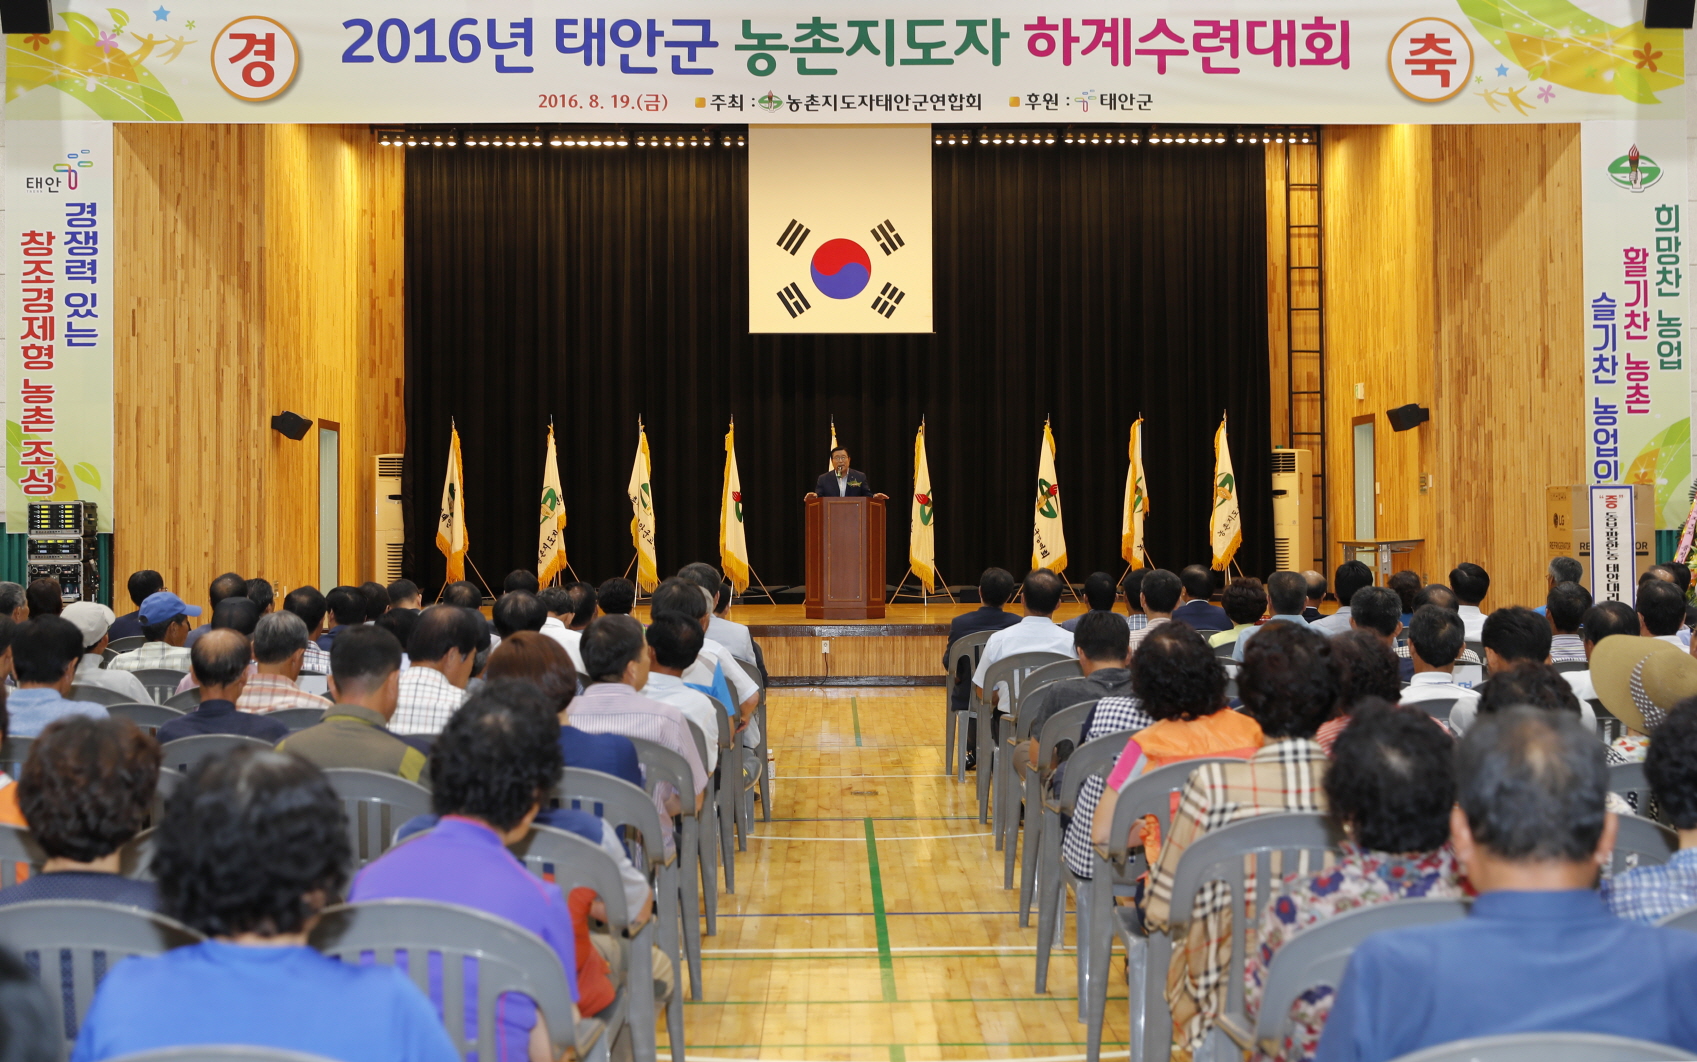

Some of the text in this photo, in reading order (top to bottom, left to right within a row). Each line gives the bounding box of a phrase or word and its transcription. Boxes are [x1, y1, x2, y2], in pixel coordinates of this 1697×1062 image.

[228, 33, 275, 87] 경
[342, 16, 1351, 77] 2016년 태안군 농촌지도자 하계수련대회
[1405, 33, 1457, 88] 축
[538, 94, 669, 112] 2016. 8. 19.(금)
[710, 94, 744, 112] 주최
[785, 93, 982, 112] 농촌지도자태안군연합회
[1025, 92, 1058, 111] 후원
[1100, 93, 1153, 111] 태안군
[26, 177, 62, 193] 태안
[63, 202, 99, 347] 경쟁력 있는
[1654, 204, 1683, 370] 희망찬 농업
[1591, 292, 1619, 384] 슬기찬
[1622, 246, 1651, 414] 활기찬 농촌
[19, 230, 56, 495] 창조경제형 농촌 조성
